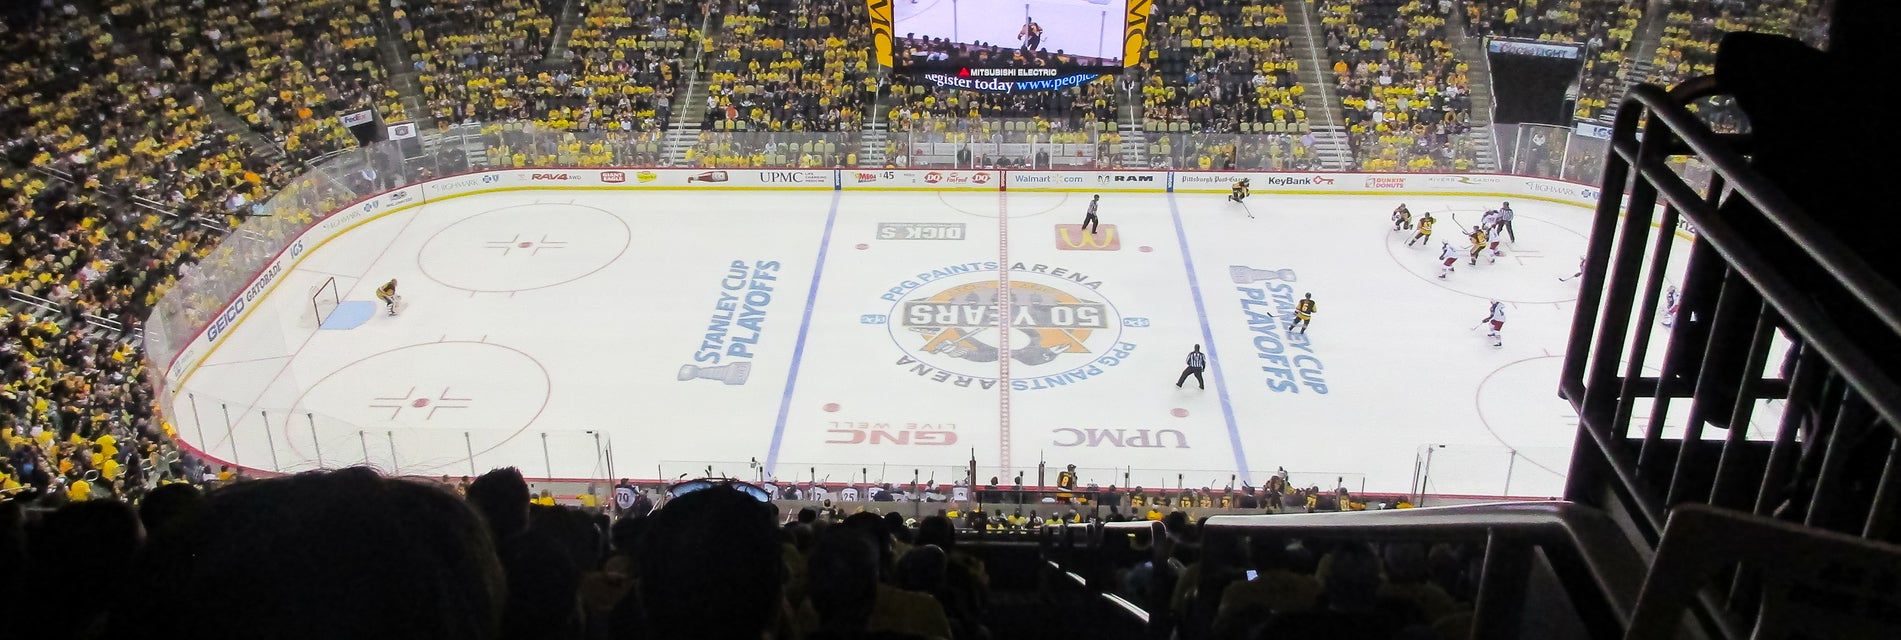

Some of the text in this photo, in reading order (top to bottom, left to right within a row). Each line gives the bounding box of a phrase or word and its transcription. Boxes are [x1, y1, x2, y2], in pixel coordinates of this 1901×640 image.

[970, 68, 1057, 76] MITSUBISHI ELECTRIC
[975, 78, 1013, 93] today
[760, 171, 803, 182] UPMC
[1015, 174, 1050, 183] Walmart
[1268, 177, 1311, 185] KeyBank
[290, 240, 303, 259] IGS
[246, 261, 281, 302] GATORADE
[880, 280, 920, 302] PPG
[916, 261, 999, 282] PAINTS
[1010, 262, 1103, 290] ARENA
[207, 298, 245, 342] GEICO
[694, 260, 750, 364] STANLEY CUP
[726, 260, 780, 359] PLAYOFFS
[909, 304, 1101, 326] 50 YEARS
[1236, 286, 1299, 394] PLAYOFFS
[895, 341, 1137, 391] PPG PAINTS ARENA
[1292, 354, 1328, 394] CUP
[828, 421, 890, 429] WELL
[825, 429, 958, 446] GNC
[1052, 427, 1191, 449] UPMC
[617, 492, 629, 503] 70
